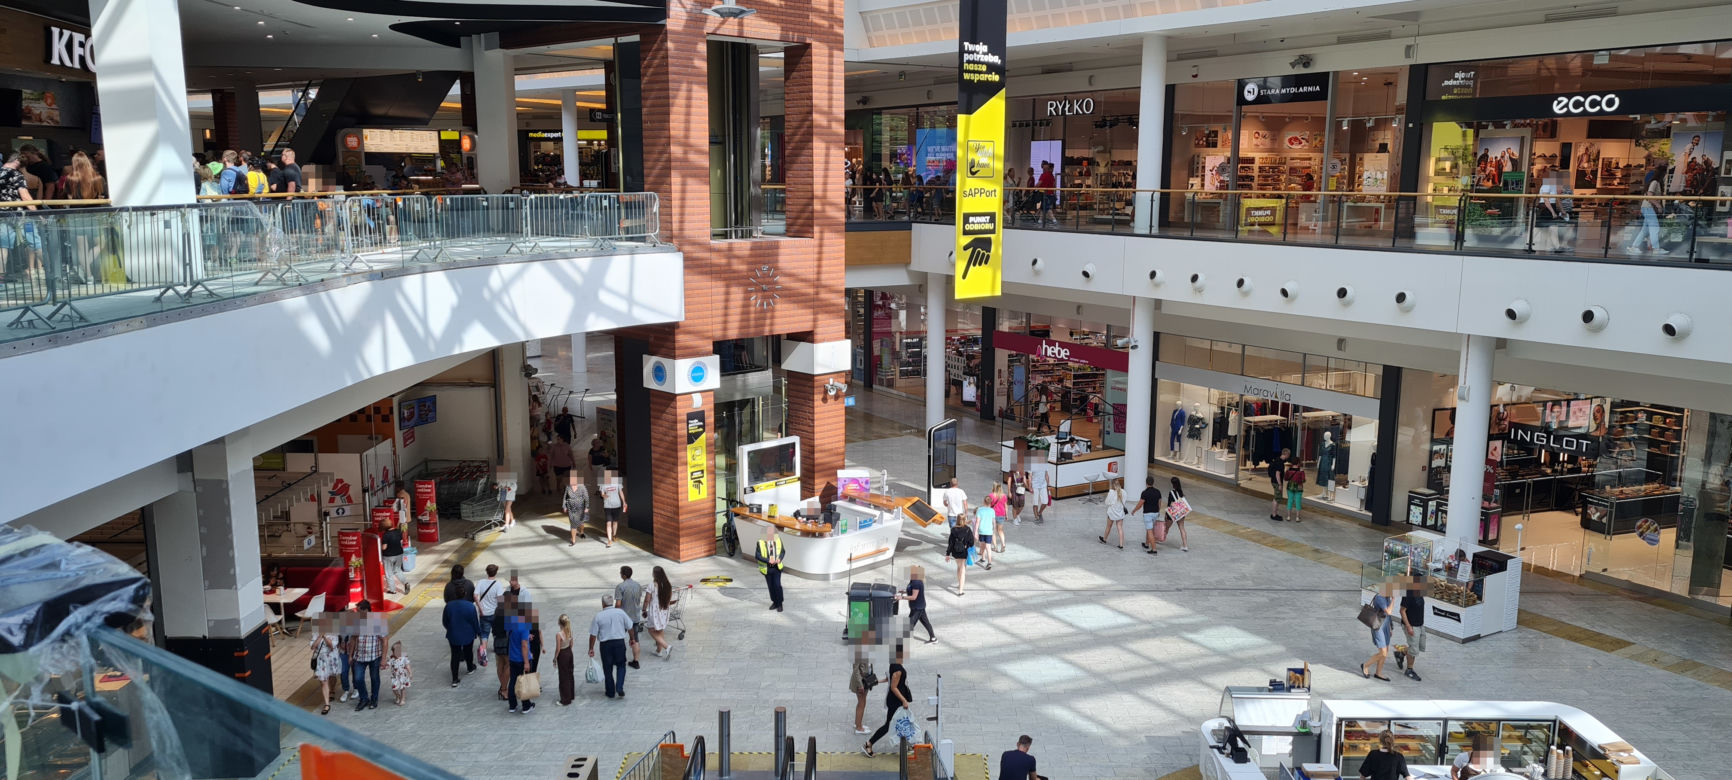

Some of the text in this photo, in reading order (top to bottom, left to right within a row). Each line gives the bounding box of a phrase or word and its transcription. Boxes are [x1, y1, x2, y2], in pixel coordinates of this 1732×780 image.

[963, 41, 988, 55] Twoja
[963, 52, 1002, 65] potrzeba,
[963, 63, 987, 72] nasze
[963, 71, 1000, 83] wsparcie
[1260, 88, 1280, 96] STARA
[1047, 97, 1094, 116] RYŁKO
[1552, 93, 1620, 114] ecco
[528, 131, 562, 139] mediaexpert
[963, 187, 998, 198] sAPPort
[969, 215, 991, 223] PUNKT
[964, 223, 994, 231] ODBIORU
[1042, 339, 1070, 360] hebe
[1510, 428, 1591, 453] INGLOT
